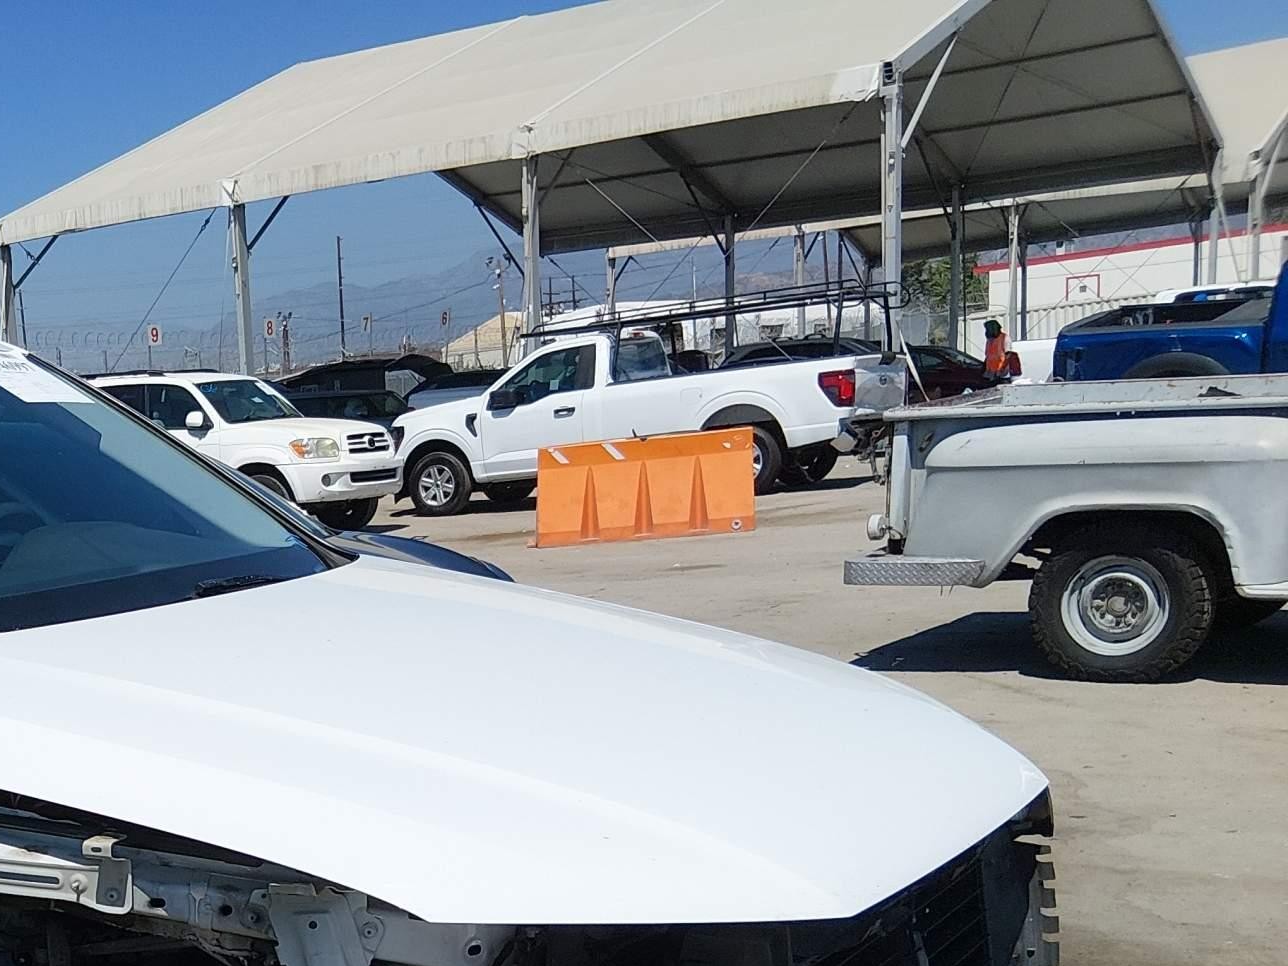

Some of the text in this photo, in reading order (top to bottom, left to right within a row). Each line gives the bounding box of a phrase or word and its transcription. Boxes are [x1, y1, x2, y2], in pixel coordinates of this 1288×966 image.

[266, 320, 273, 336] 8
[362, 316, 369, 332] 7
[150, 327, 159, 343] 9
